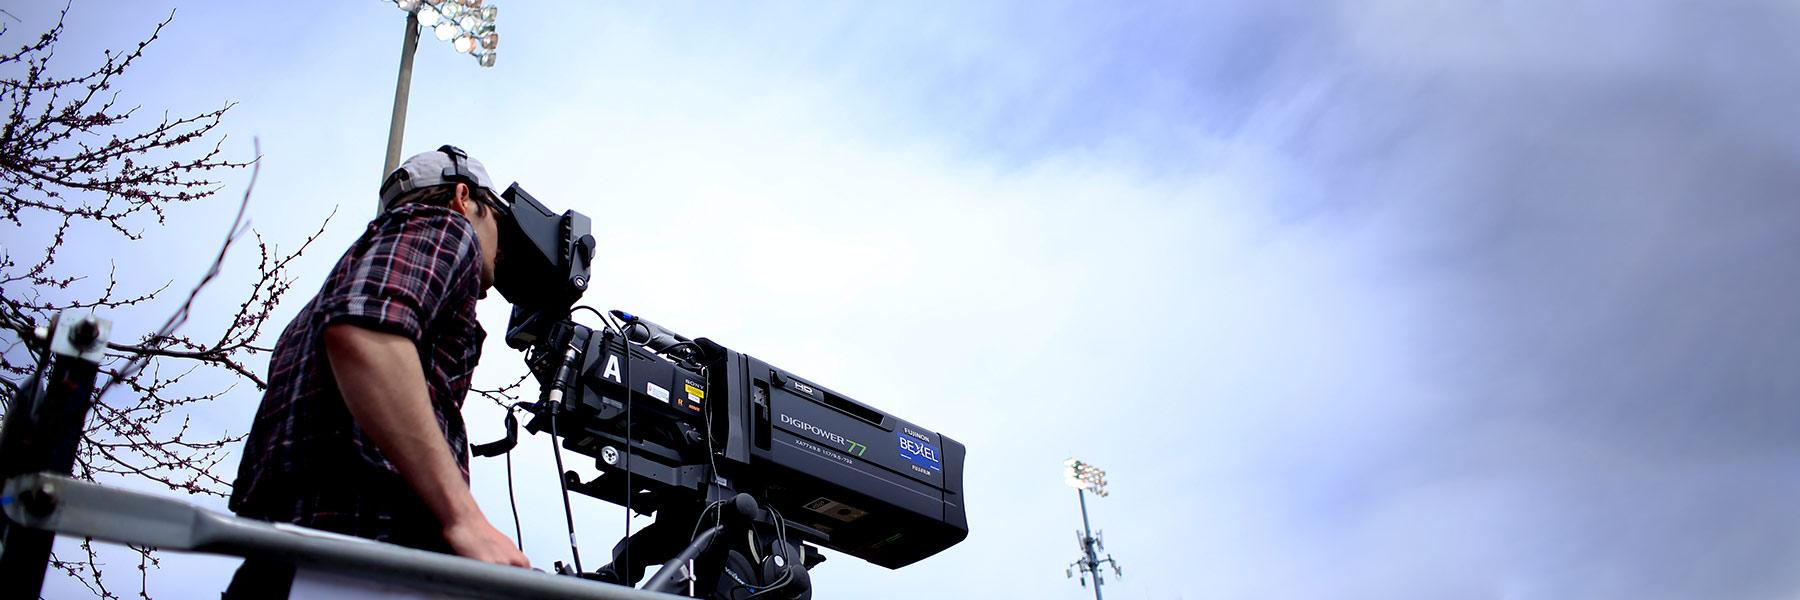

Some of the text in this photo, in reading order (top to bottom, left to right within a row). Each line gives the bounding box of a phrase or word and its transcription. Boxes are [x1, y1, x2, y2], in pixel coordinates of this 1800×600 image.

[603, 354, 622, 384] A
[685, 379, 704, 390] SONY
[794, 382, 813, 394] HD
[780, 414, 867, 457] DIGIPOWER 77
[904, 427, 930, 443] FUJINON
[899, 436, 939, 463] BEXEL
